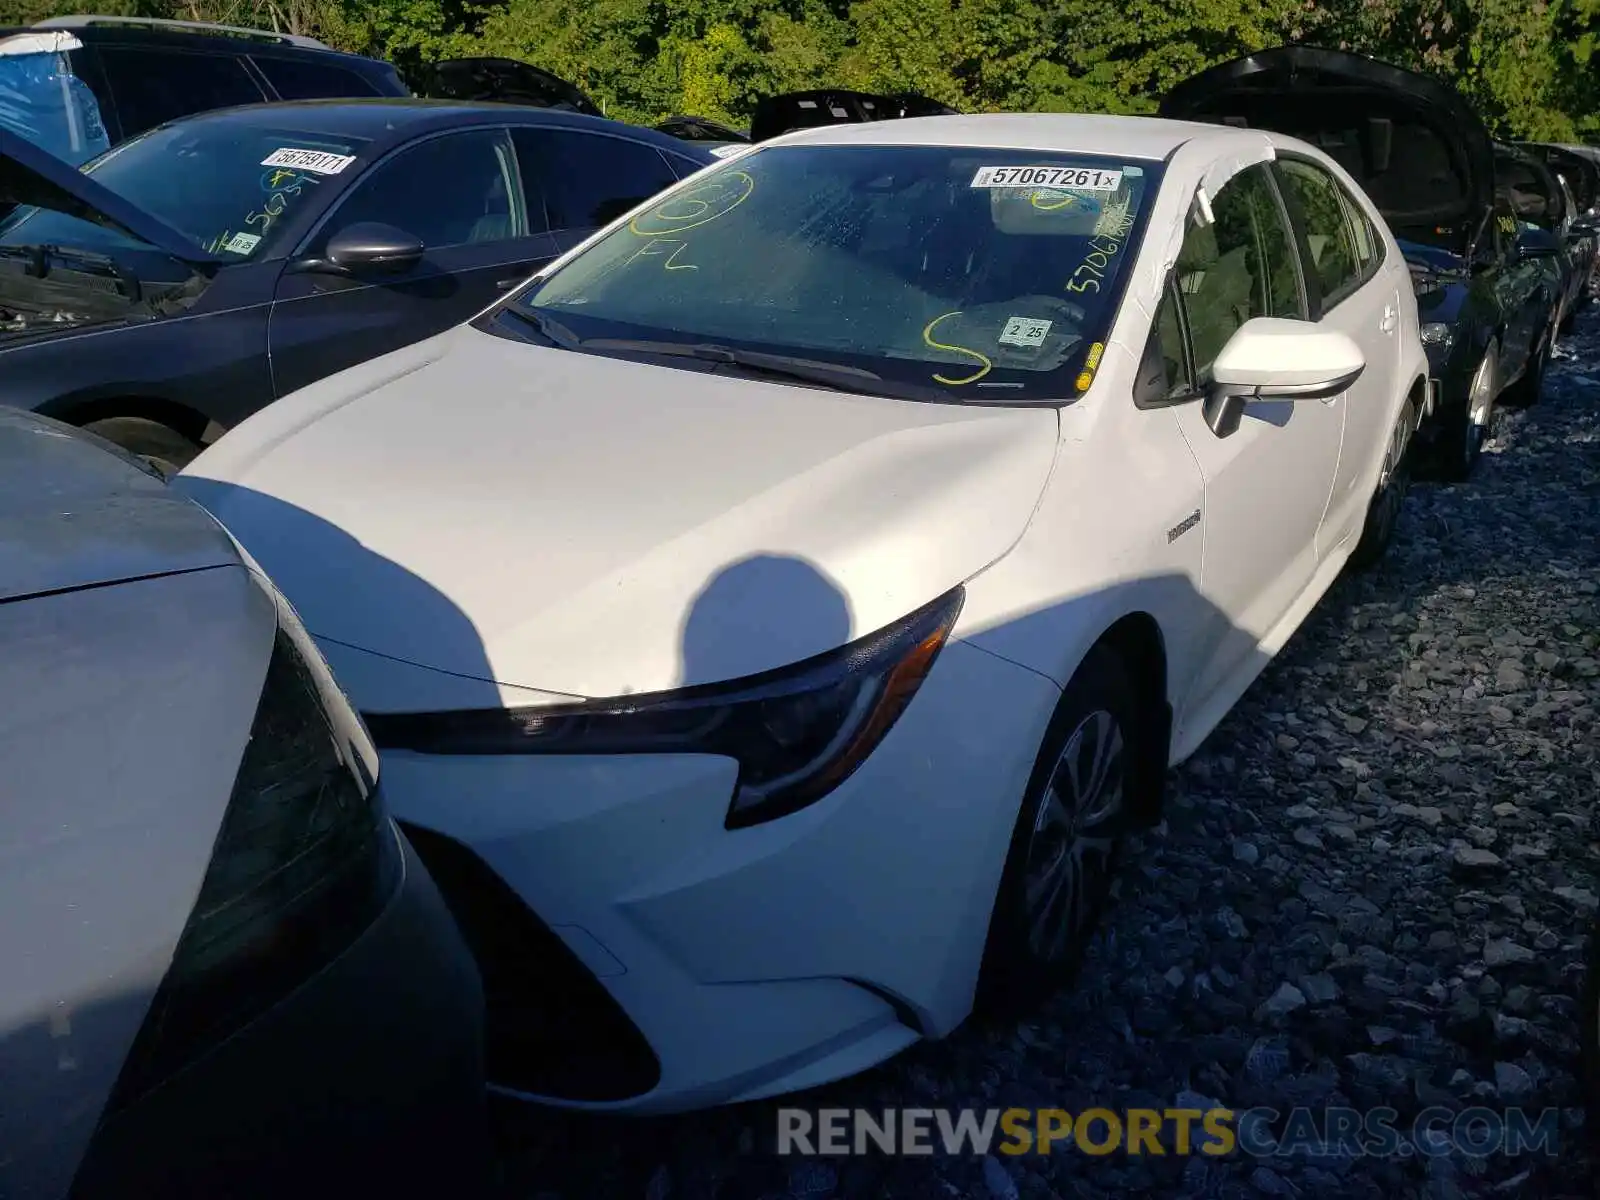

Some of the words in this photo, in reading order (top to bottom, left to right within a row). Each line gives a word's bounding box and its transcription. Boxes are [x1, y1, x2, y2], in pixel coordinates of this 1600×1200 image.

[276, 149, 345, 170] 56759171
[1009, 324, 1021, 336] 2
[1026, 326, 1044, 338] 25
